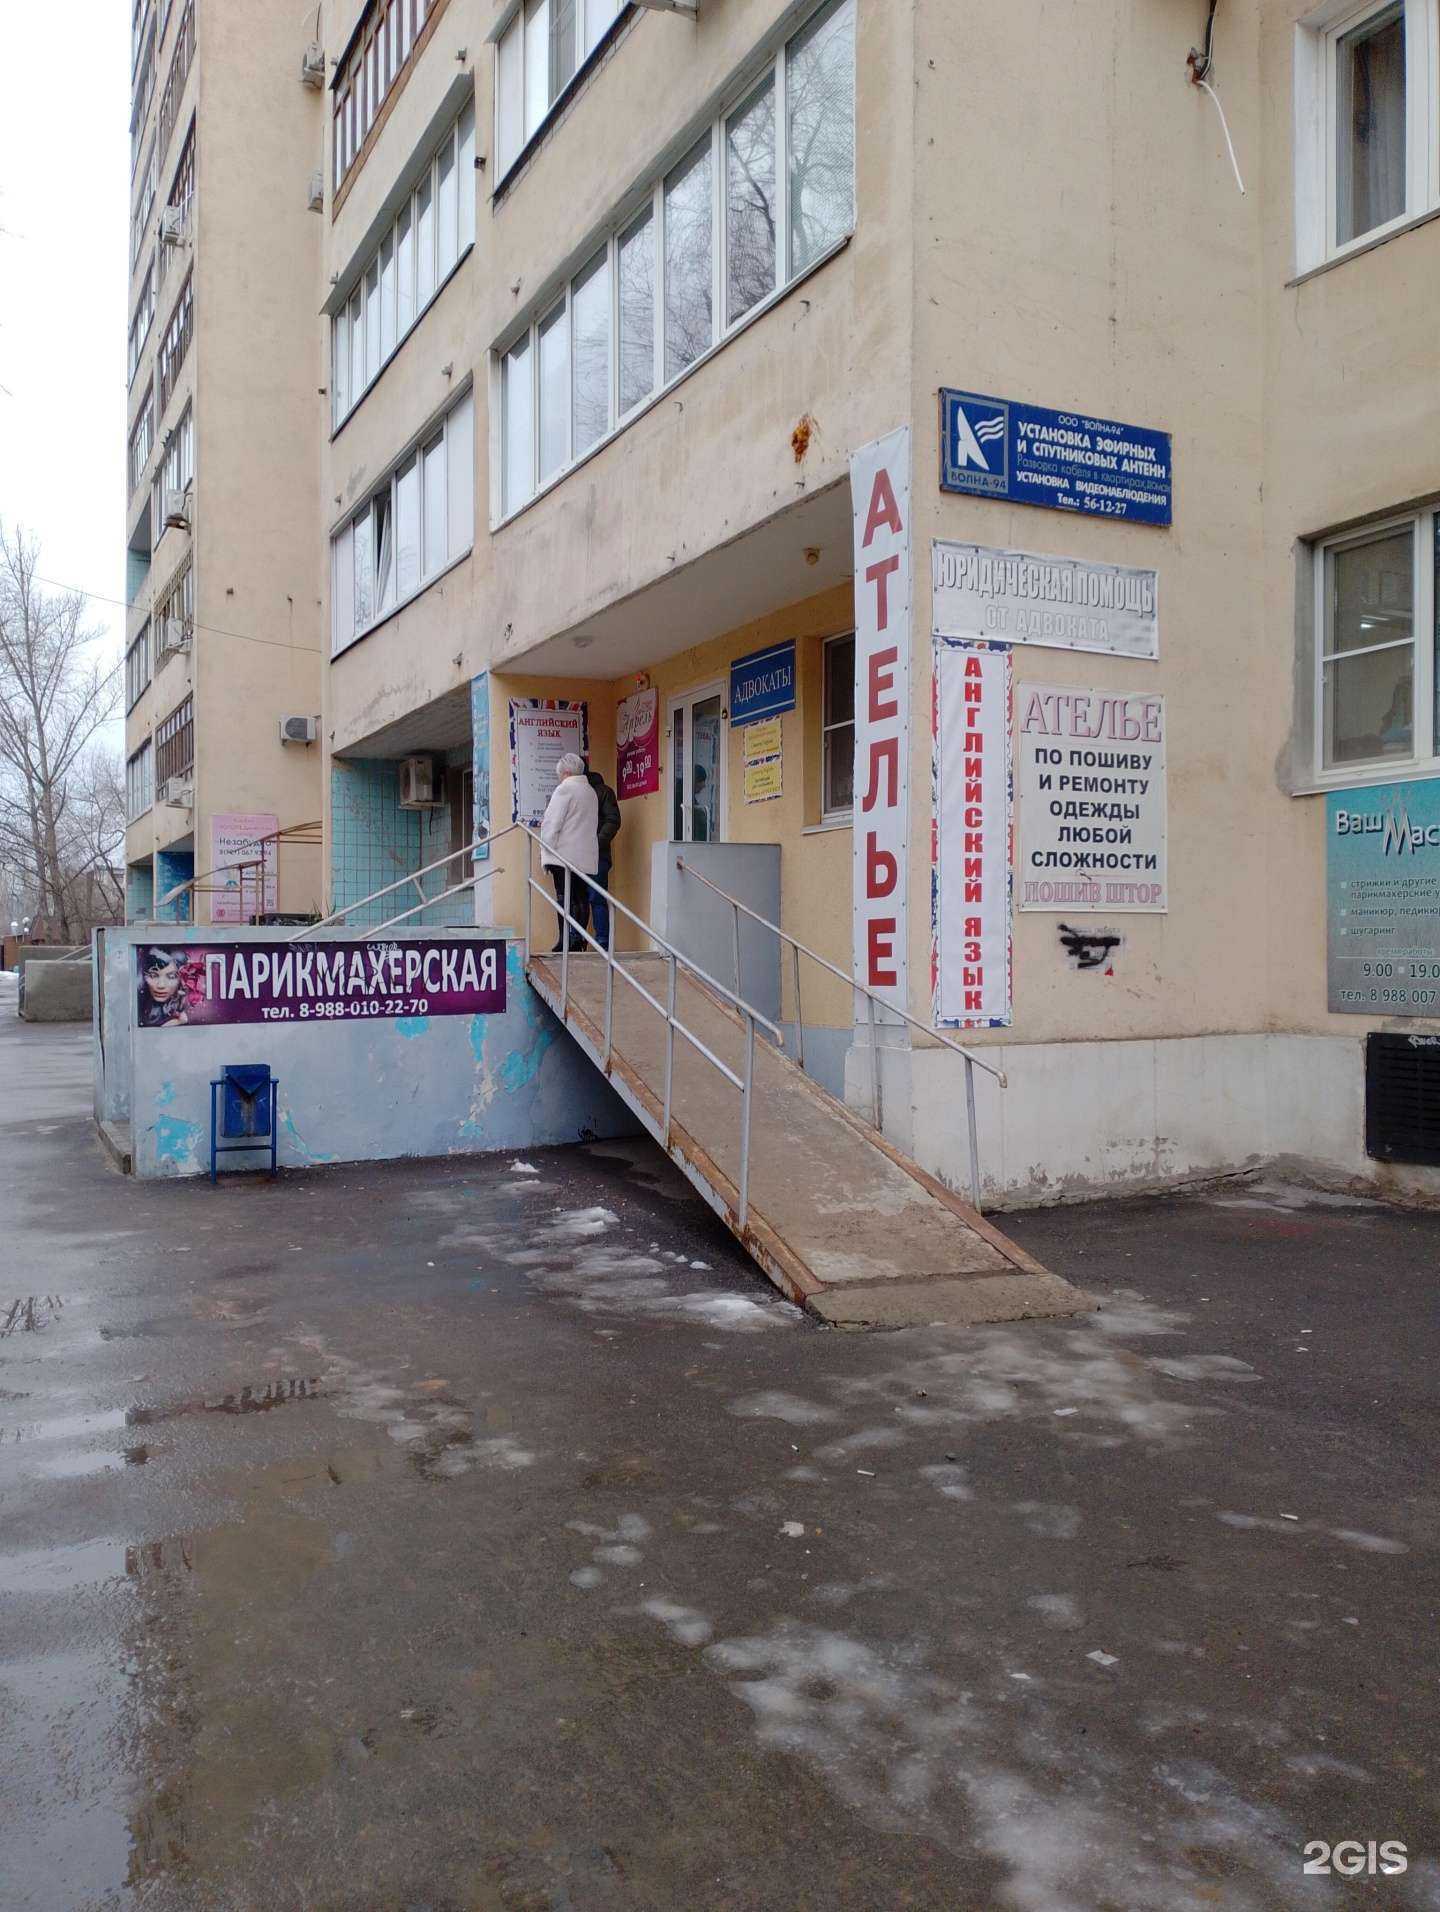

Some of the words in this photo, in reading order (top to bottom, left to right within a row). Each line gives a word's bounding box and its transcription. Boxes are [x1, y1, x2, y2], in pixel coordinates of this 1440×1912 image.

[1058, 414, 1078, 427] ООО
[1018, 421, 1091, 449] УСТАНОВКА
[1096, 436, 1156, 461] ЭФИРНЫХ
[1017, 438, 1027, 454] И
[1032, 441, 1118, 470] СПУТНИКОВЫХ
[1121, 459, 1166, 480] АНТЕНН
[1017, 453, 1058, 475] Разводка
[951, 471, 1007, 490] ВОЛНА-94
[1016, 470, 1070, 490] УСТАНОВКА
[1075, 480, 1167, 507] ВИДЕОНАБЛЮДЕНИЯ
[1057, 492, 1080, 507] Тел.:
[1083, 497, 1127, 515] 56-12-27
[938, 551, 1075, 604] ЮРИДИЧЕСКАЯ
[1077, 569, 1154, 619] ПОМОЩЬ
[985, 603, 1009, 632] ОТ
[1015, 608, 1110, 642] АДВОКАТА
[734, 665, 791, 705] АДВОКАТЫ
[519, 717, 578, 729] АНГЛИЙСКИЙ
[861, 466, 903, 989] АТЕЛЬЕ
[1020, 691, 1162, 743] АТЕЛЬЕ
[537, 729, 561, 738] ЯЗЫК
[1035, 748, 1062, 765] ПО
[1070, 750, 1152, 770] ПОШИВУ
[963, 656, 983, 903] АНГЛИЙСКИЙ
[1039, 774, 1052, 790] И
[1059, 775, 1149, 795] РЕМОНТУ
[1050, 800, 1140, 822] ОДЕЖДЫ
[1335, 809, 1385, 836] Ваш
[1058, 825, 1132, 844] ЛЮБОЙ
[1031, 851, 1157, 870] СЛОЖНОСТИ
[1024, 881, 1104, 903] ПОШИВ
[1106, 882, 1162, 904] ШТОР
[1351, 880, 1391, 891] стрижки
[1393, 879, 1400, 887] и
[1401, 876, 1437, 889] другие
[1351, 888, 1432, 900] парикмахерские
[1351, 907, 1397, 917] маникюр,
[1351, 926, 1396, 937] шугаринг
[205, 948, 497, 1000] ПАРИКМАХЕРСКАЯ
[963, 917, 984, 1011] ЯЗЫК
[1363, 963, 1393, 977] 9.00
[1341, 990, 1365, 1001] тел.
[1370, 988, 1378, 1001] 8
[1383, 989, 1407, 1002] 988
[1412, 990, 1436, 1003] 007
[262, 1006, 294, 1019] тел.
[299, 999, 428, 1018] 8-988-010-22-70
